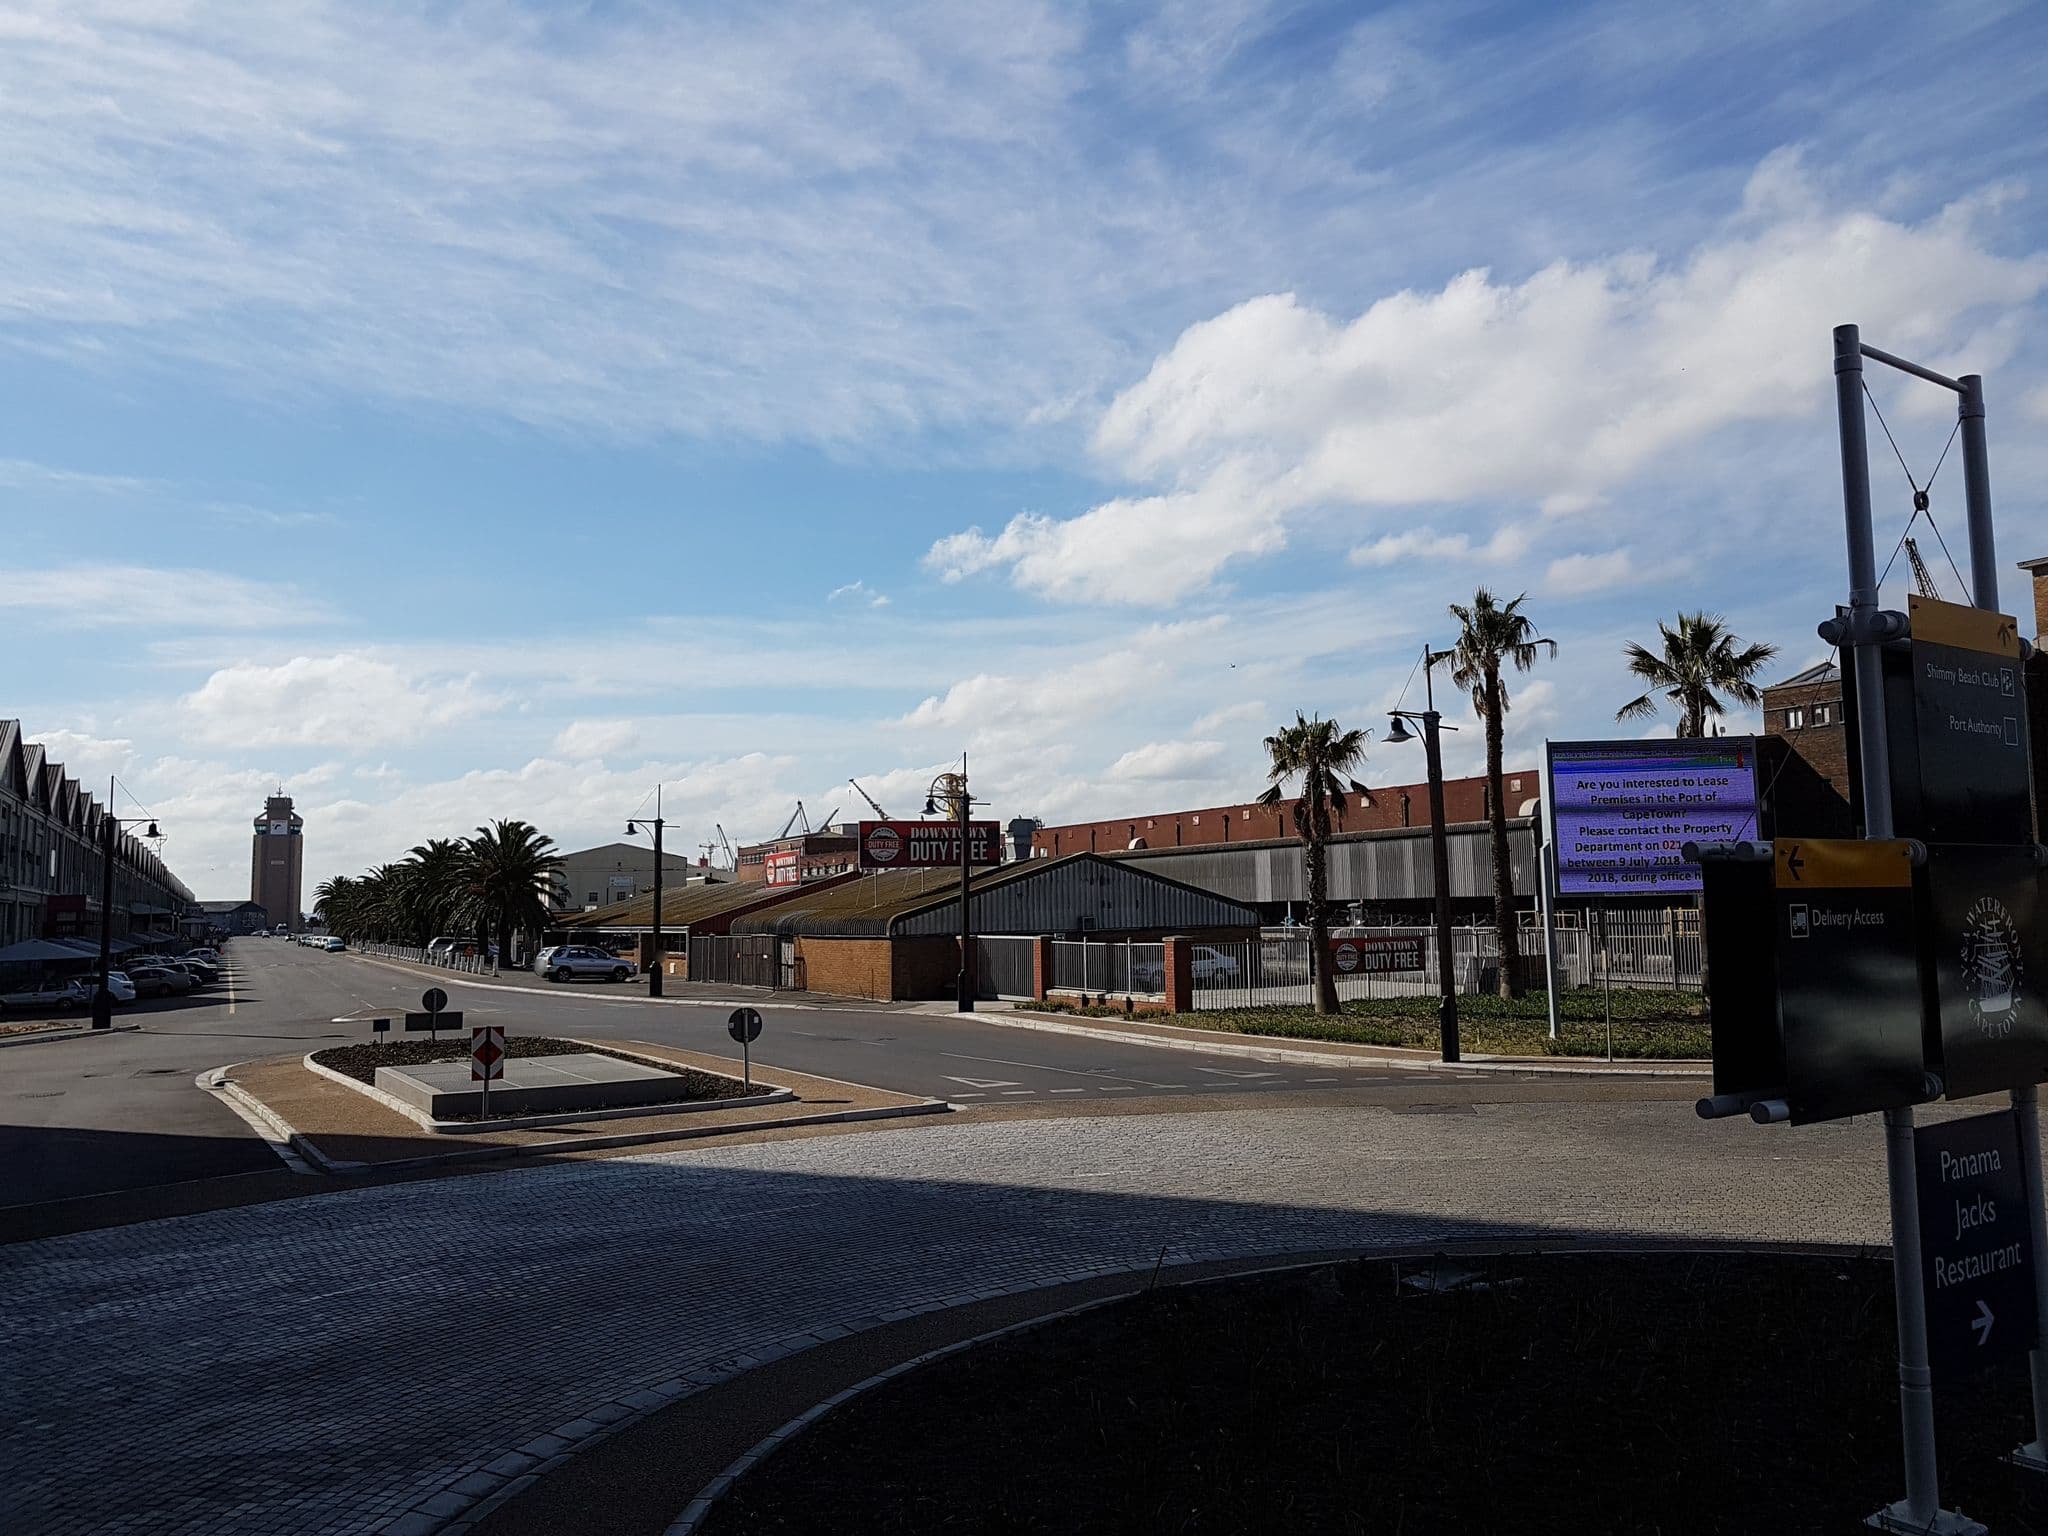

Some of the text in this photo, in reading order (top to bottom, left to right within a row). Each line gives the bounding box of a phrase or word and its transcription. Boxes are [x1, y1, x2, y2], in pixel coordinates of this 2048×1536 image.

[1926, 663, 2000, 688] Shimmy Beach Club
[1949, 715, 2002, 739] Port Authority
[1576, 776, 1729, 791] Are you interested to Lease
[1591, 791, 1717, 805] Premises in the Port of
[910, 826, 988, 839] DOWNTWN
[1579, 823, 1732, 836] Please contact the Property
[868, 840, 899, 848] DUTY FREE
[910, 841, 948, 861] DUTY
[953, 841, 988, 860] FEE
[1575, 841, 1642, 853] Department
[1645, 842, 1659, 851] on
[1567, 857, 1616, 868] between
[1619, 857, 1626, 867] 9
[1629, 856, 1650, 868] July
[1653, 856, 1681, 866] 2018
[1588, 872, 1618, 884] 2018,
[1621, 871, 1657, 883] during
[1660, 870, 1691, 881] office
[1812, 908, 1884, 930] Delivery Access
[1365, 941, 1418, 952] DOWNTOWN
[1365, 952, 1419, 969] DUTY FREE
[1968, 998, 1995, 1039] CAPE
[1940, 1149, 2002, 1183] Panama
[1956, 1193, 1997, 1240] Jacks
[1935, 1242, 2022, 1289] Restaurant
